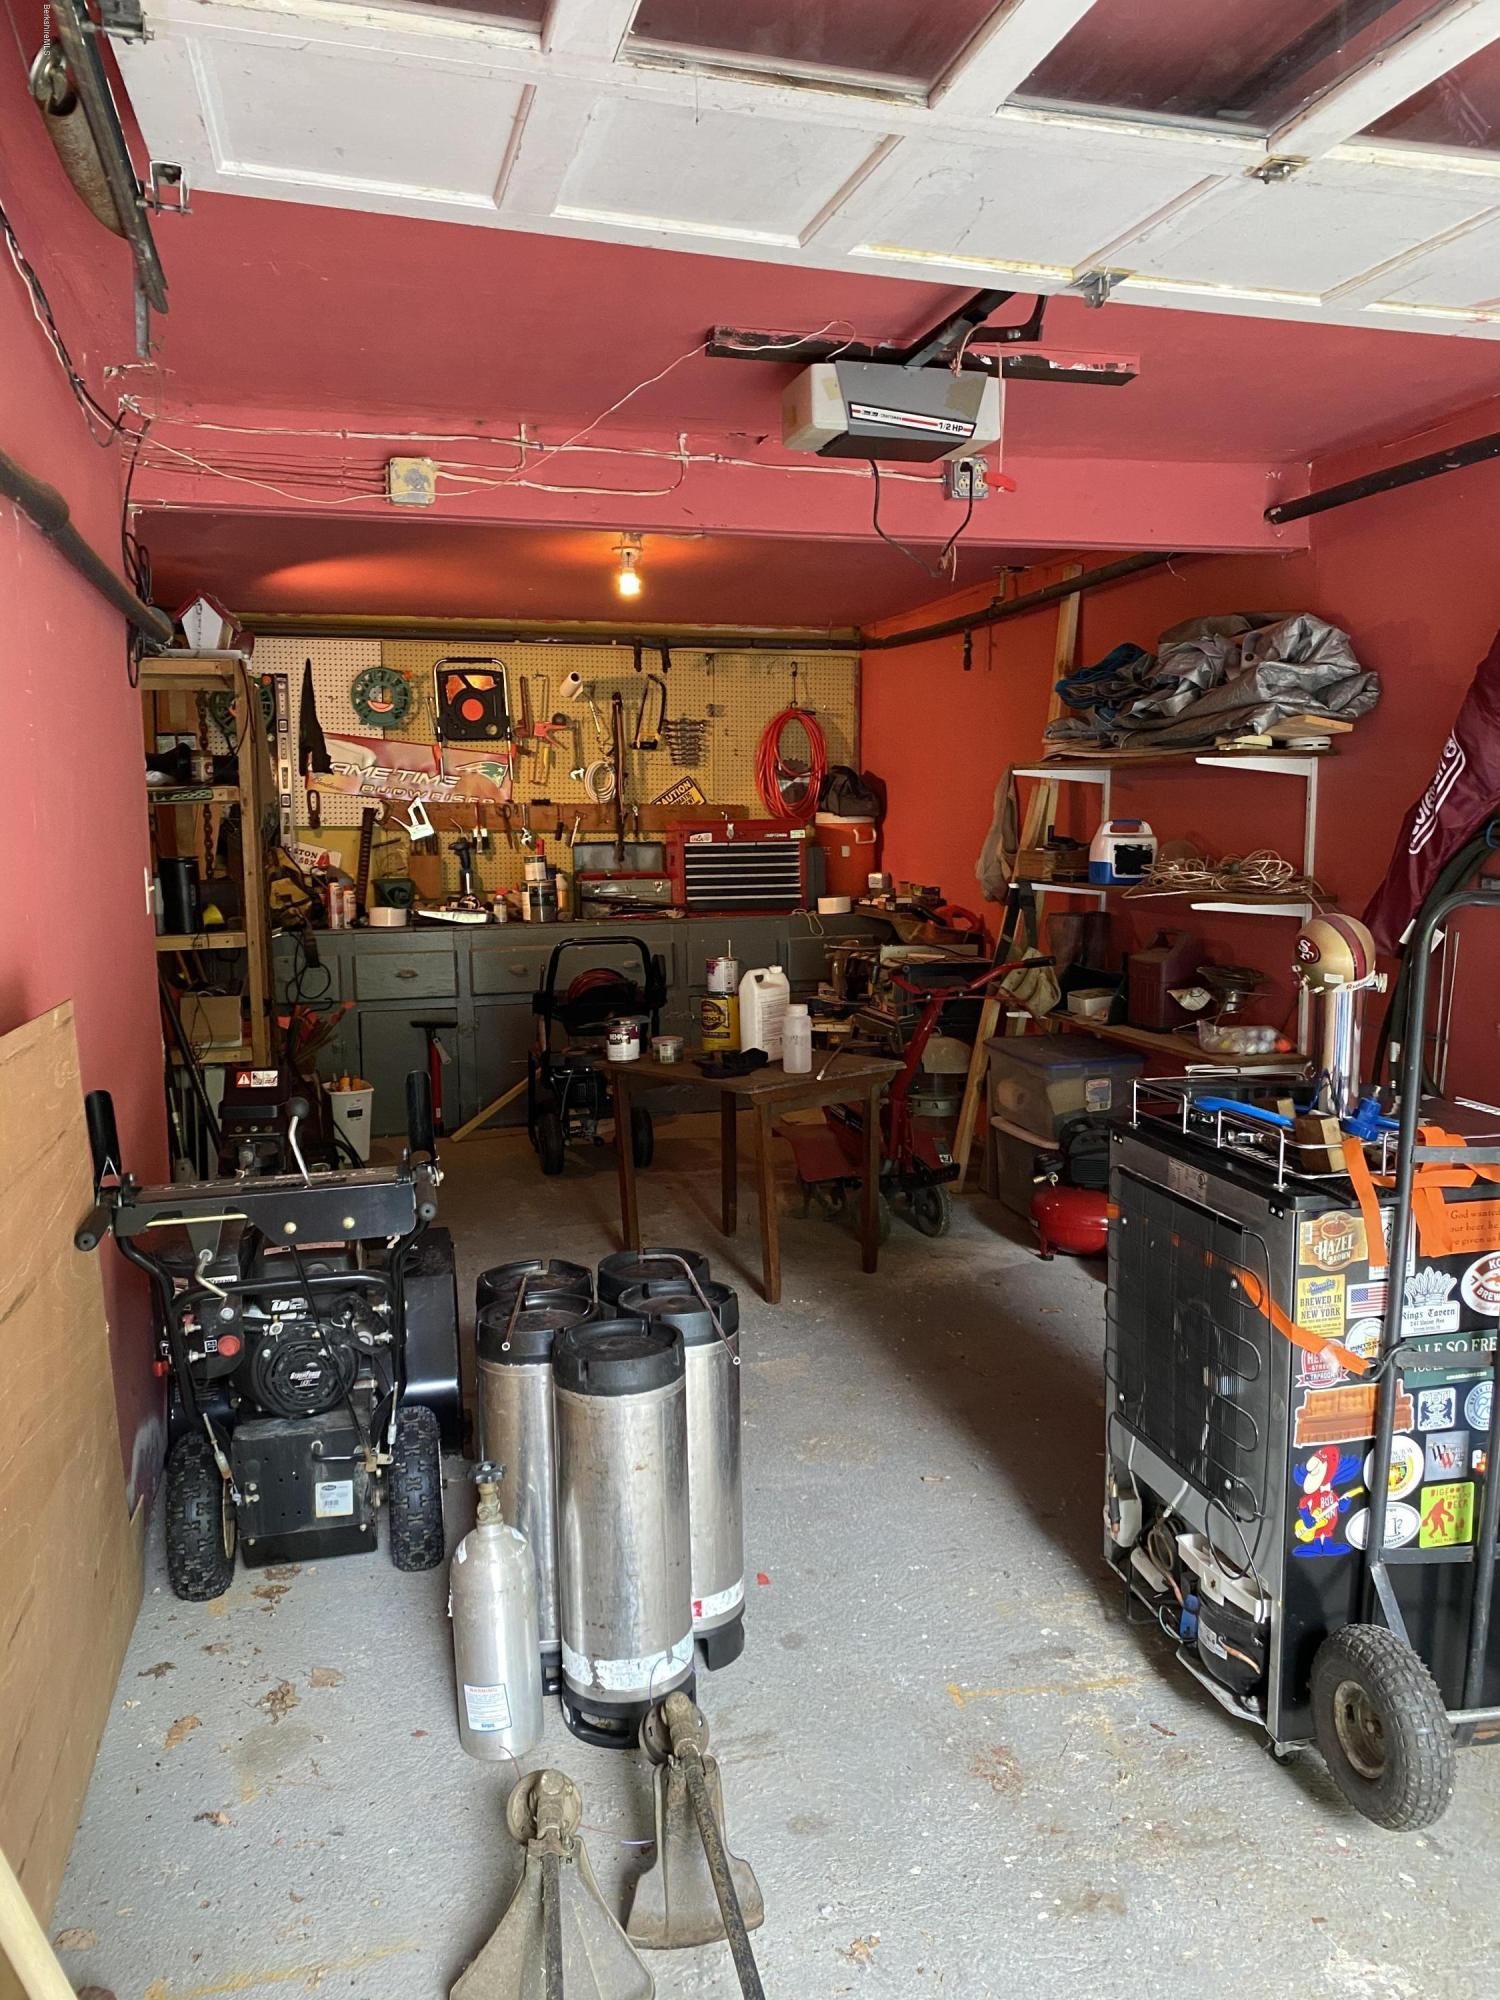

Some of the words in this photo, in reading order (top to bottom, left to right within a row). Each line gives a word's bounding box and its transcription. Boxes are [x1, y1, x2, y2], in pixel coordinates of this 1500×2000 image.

[309, 762, 393, 781] AME
[393, 769, 462, 788] TIME
[1314, 1234, 1354, 1260] HAZEL
[1300, 1296, 1332, 1307] BREWED
[1333, 1294, 1342, 1303] IN
[1301, 1309, 1319, 1319] NEW
[1321, 1307, 1341, 1317] YORK
